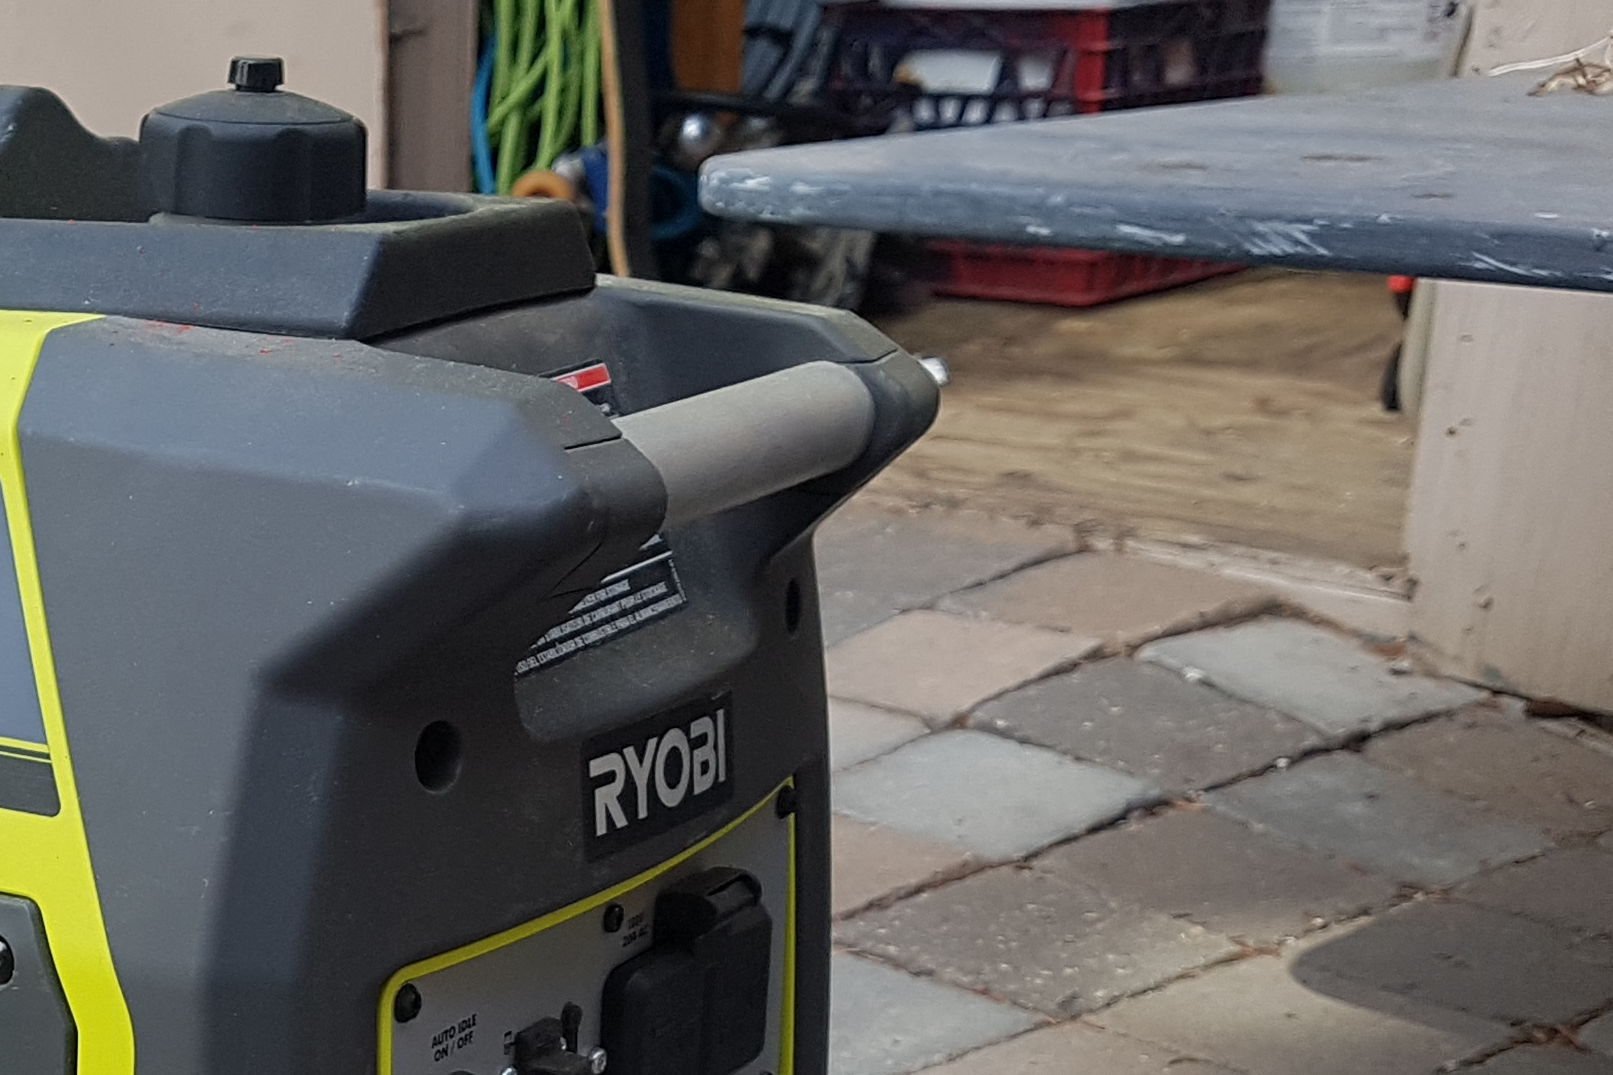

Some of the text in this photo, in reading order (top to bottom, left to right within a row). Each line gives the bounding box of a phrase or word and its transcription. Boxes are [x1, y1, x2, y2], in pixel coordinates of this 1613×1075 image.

[588, 708, 726, 838] RYOBI
[431, 1013, 477, 1049] AUTO IDLE
[433, 1046, 449, 1063] ON
[457, 1030, 474, 1049] OFF
